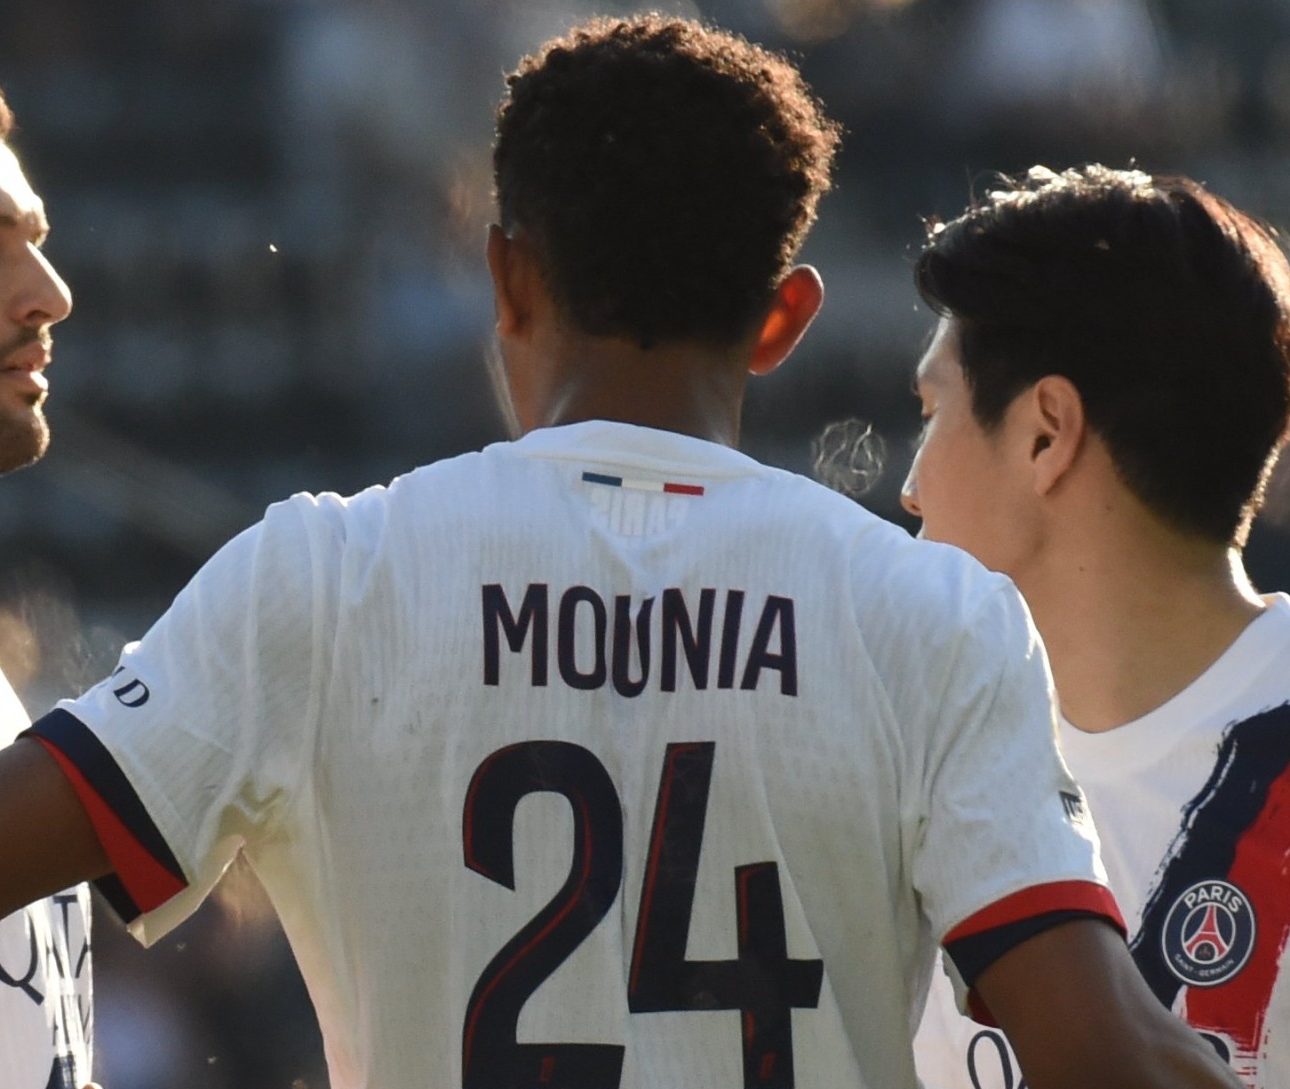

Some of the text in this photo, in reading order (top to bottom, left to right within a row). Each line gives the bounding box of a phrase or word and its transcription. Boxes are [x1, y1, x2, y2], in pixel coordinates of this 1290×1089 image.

[481, 582, 799, 697] MOUNIA
[112, 666, 150, 708] D
[1184, 885, 1243, 913] PARIS
